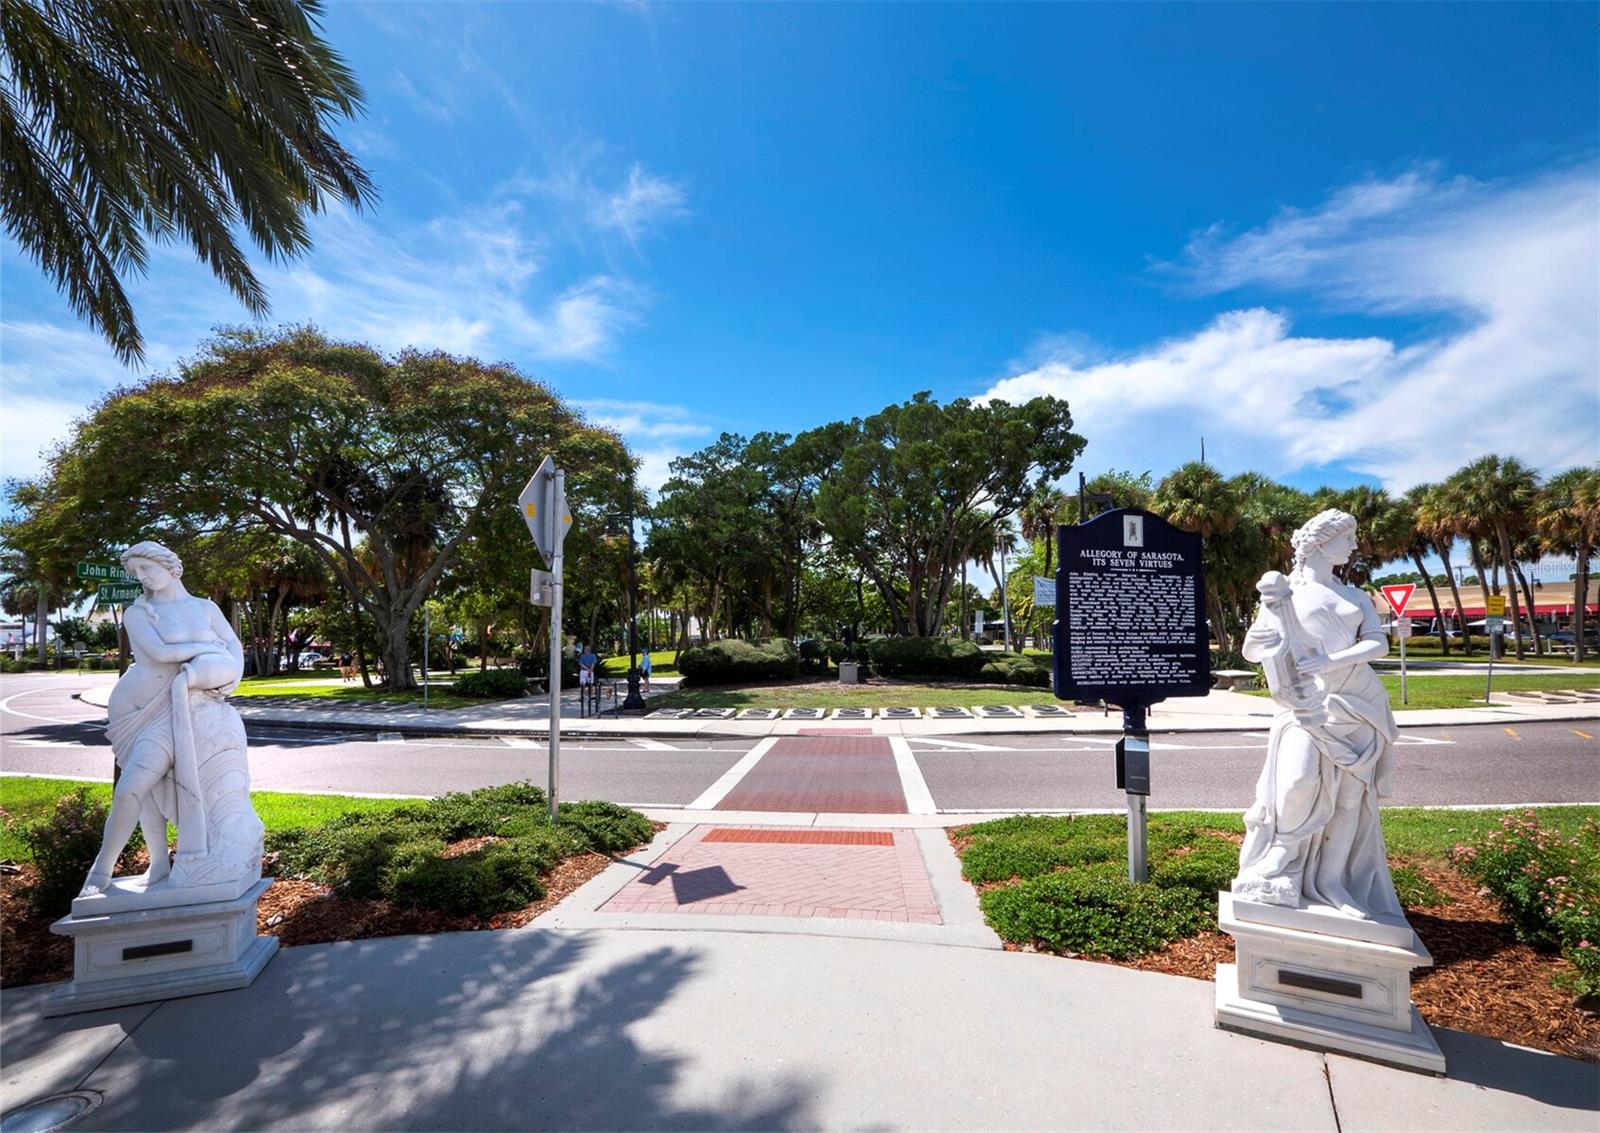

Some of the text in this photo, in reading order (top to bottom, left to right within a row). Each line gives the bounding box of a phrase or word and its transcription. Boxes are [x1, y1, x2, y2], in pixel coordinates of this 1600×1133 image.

[1080, 549, 1122, 558] ALLEGORY
[1127, 551, 1138, 559] OF
[1092, 558, 1173, 568] ITS SEVEN VIRTUES
[82, 564, 107, 577] John
[101, 587, 110, 600] St.
